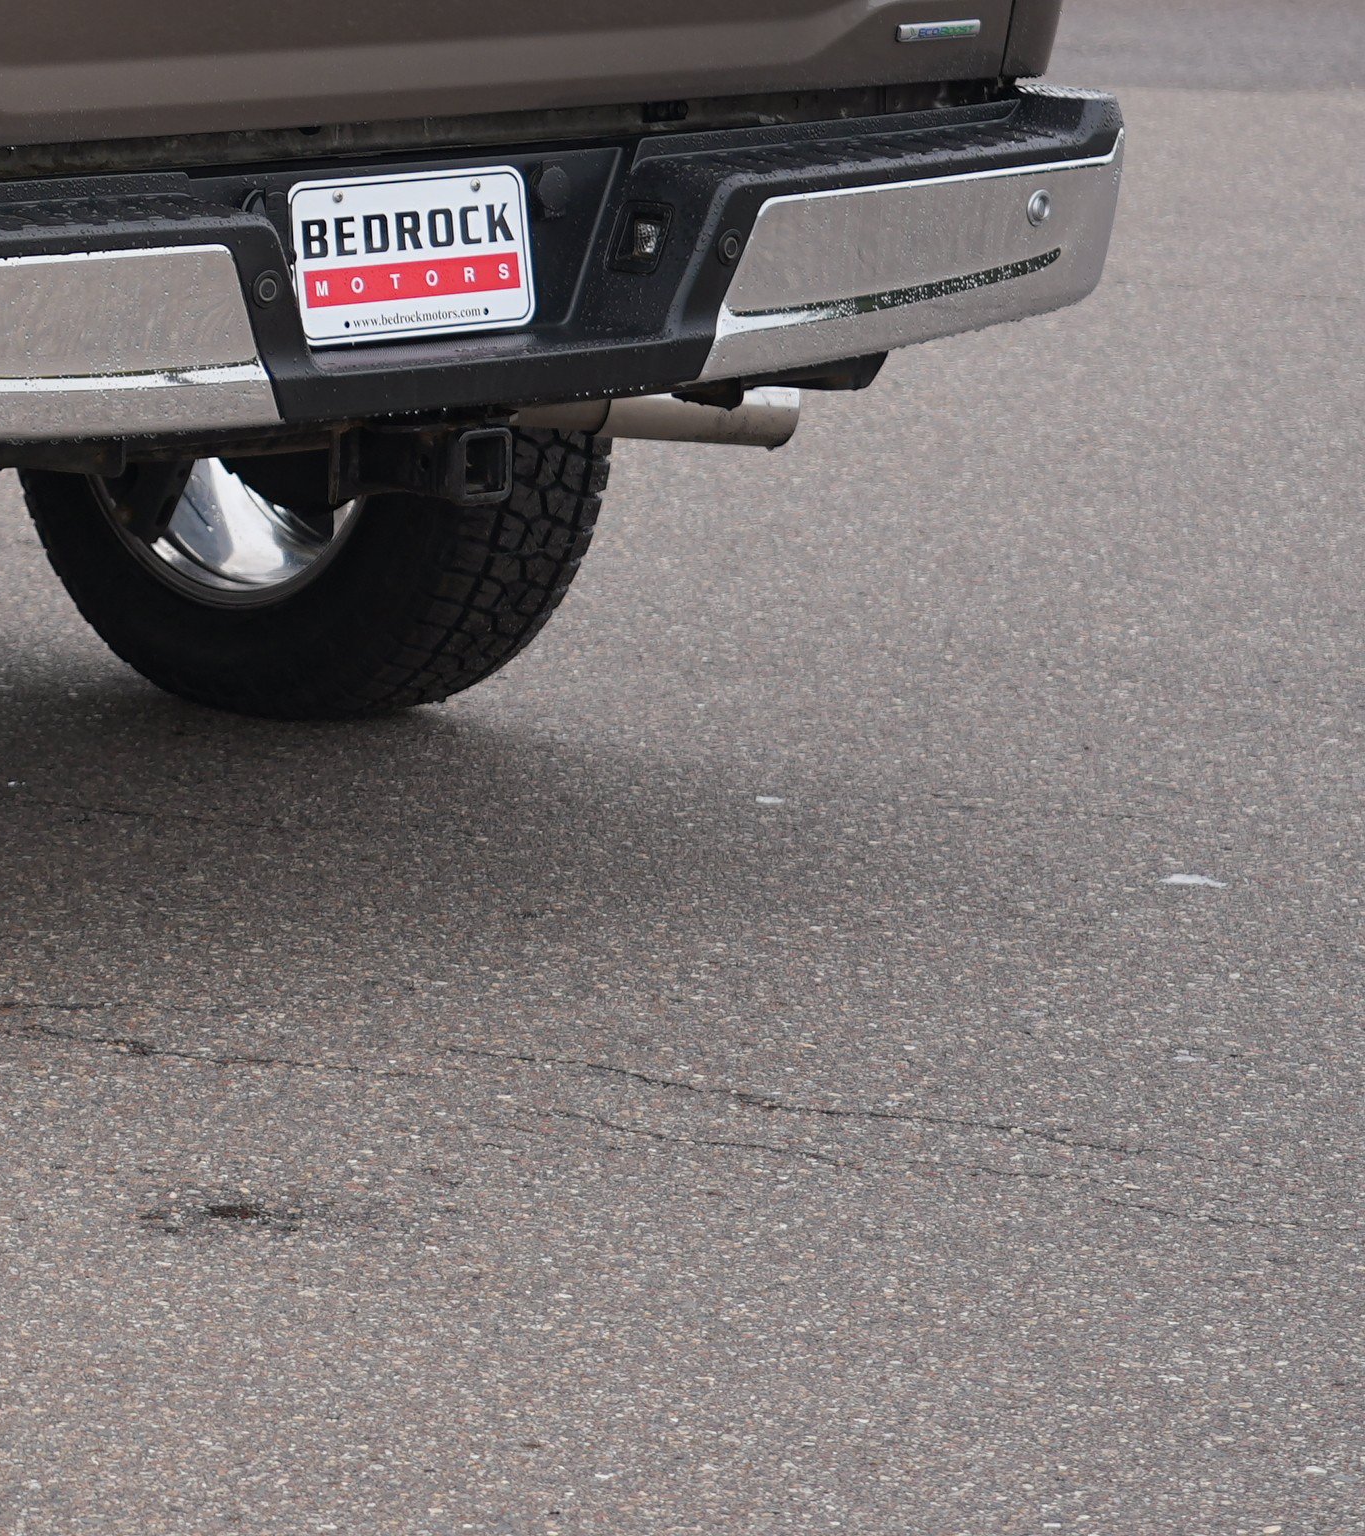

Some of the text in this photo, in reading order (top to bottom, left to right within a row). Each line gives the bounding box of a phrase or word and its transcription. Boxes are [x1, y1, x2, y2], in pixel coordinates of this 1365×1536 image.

[919, 26, 974, 37] ECOBOOST
[301, 202, 515, 260] BEDROCK
[315, 262, 511, 297] MOTORS
[353, 307, 481, 328] www.bedrockmotors.com
